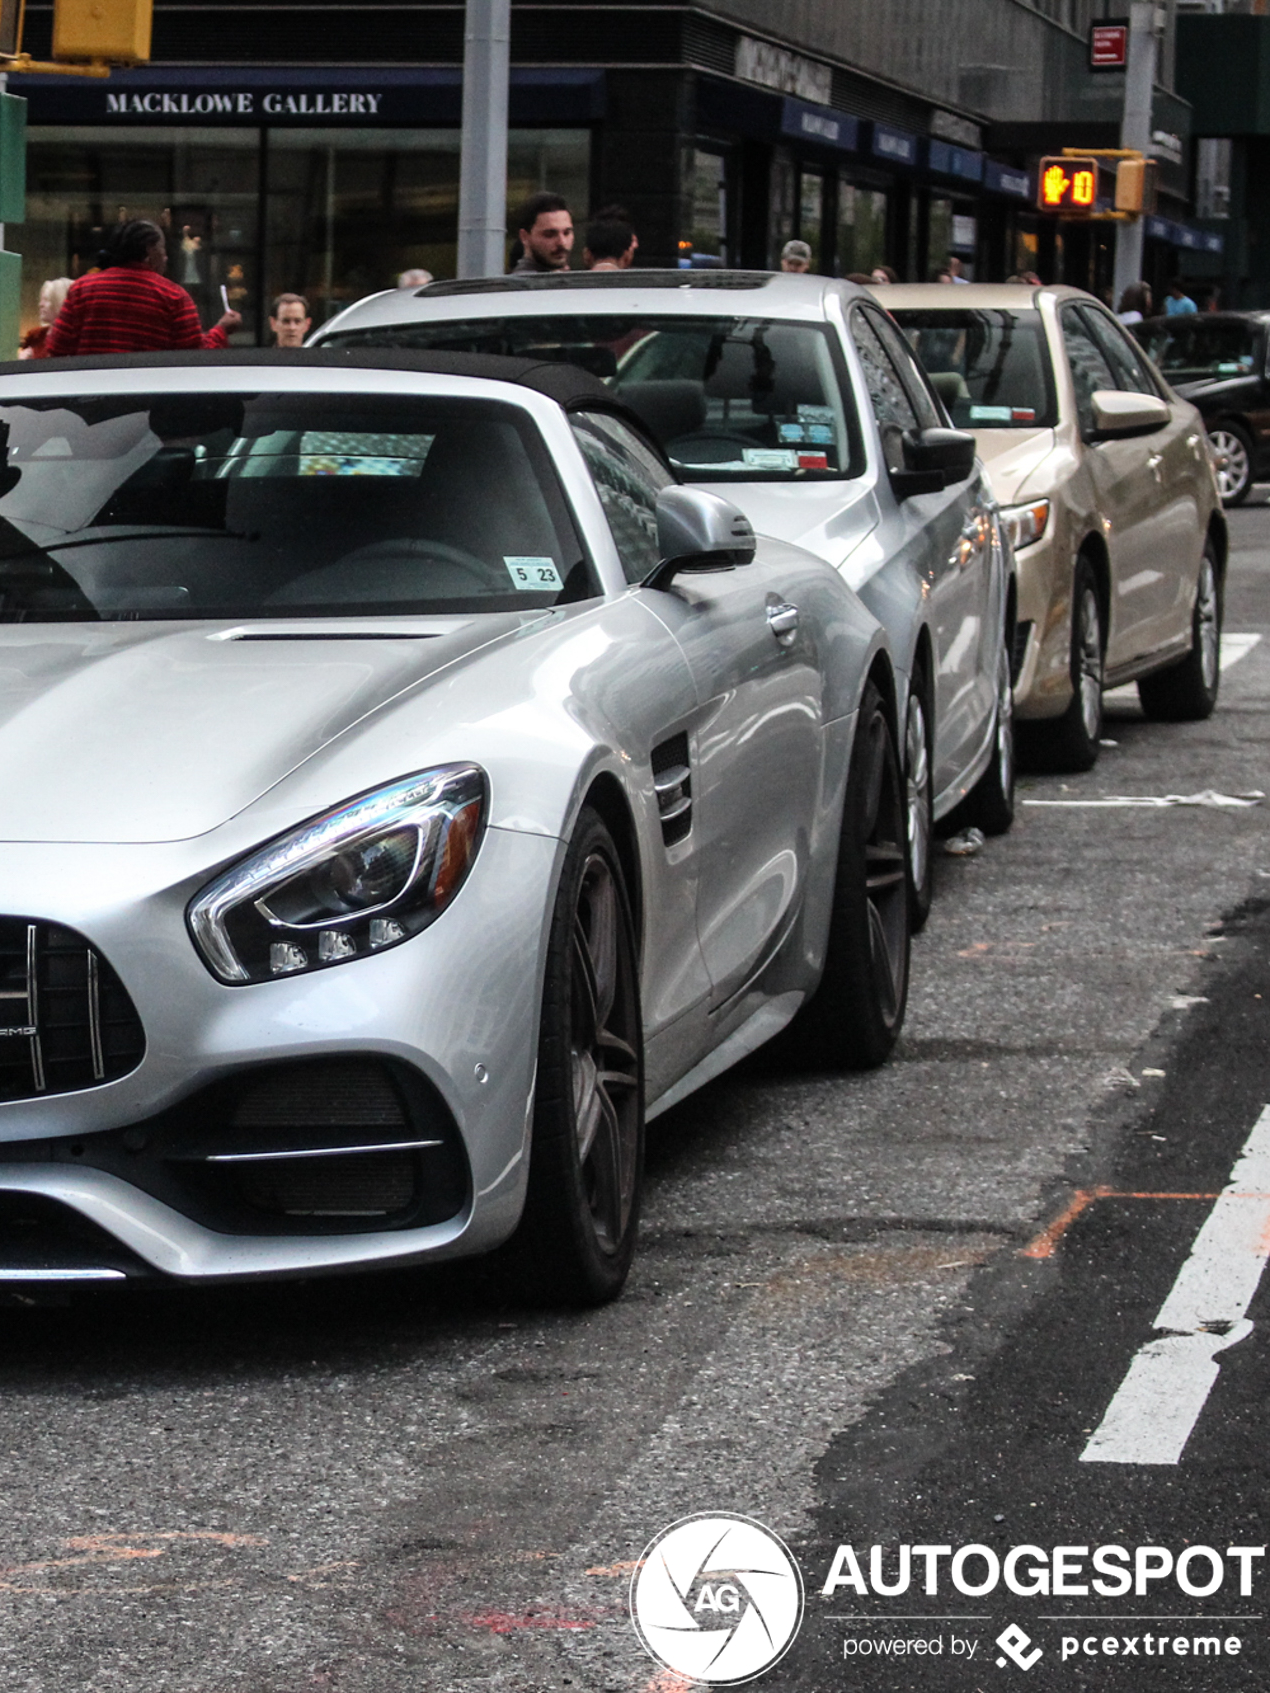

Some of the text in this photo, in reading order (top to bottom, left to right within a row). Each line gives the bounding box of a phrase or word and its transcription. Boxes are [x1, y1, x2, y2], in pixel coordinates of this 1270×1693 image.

[106, 93, 382, 114] MACKLOWE GALLERY
[516, 567, 556, 583] 5 23
